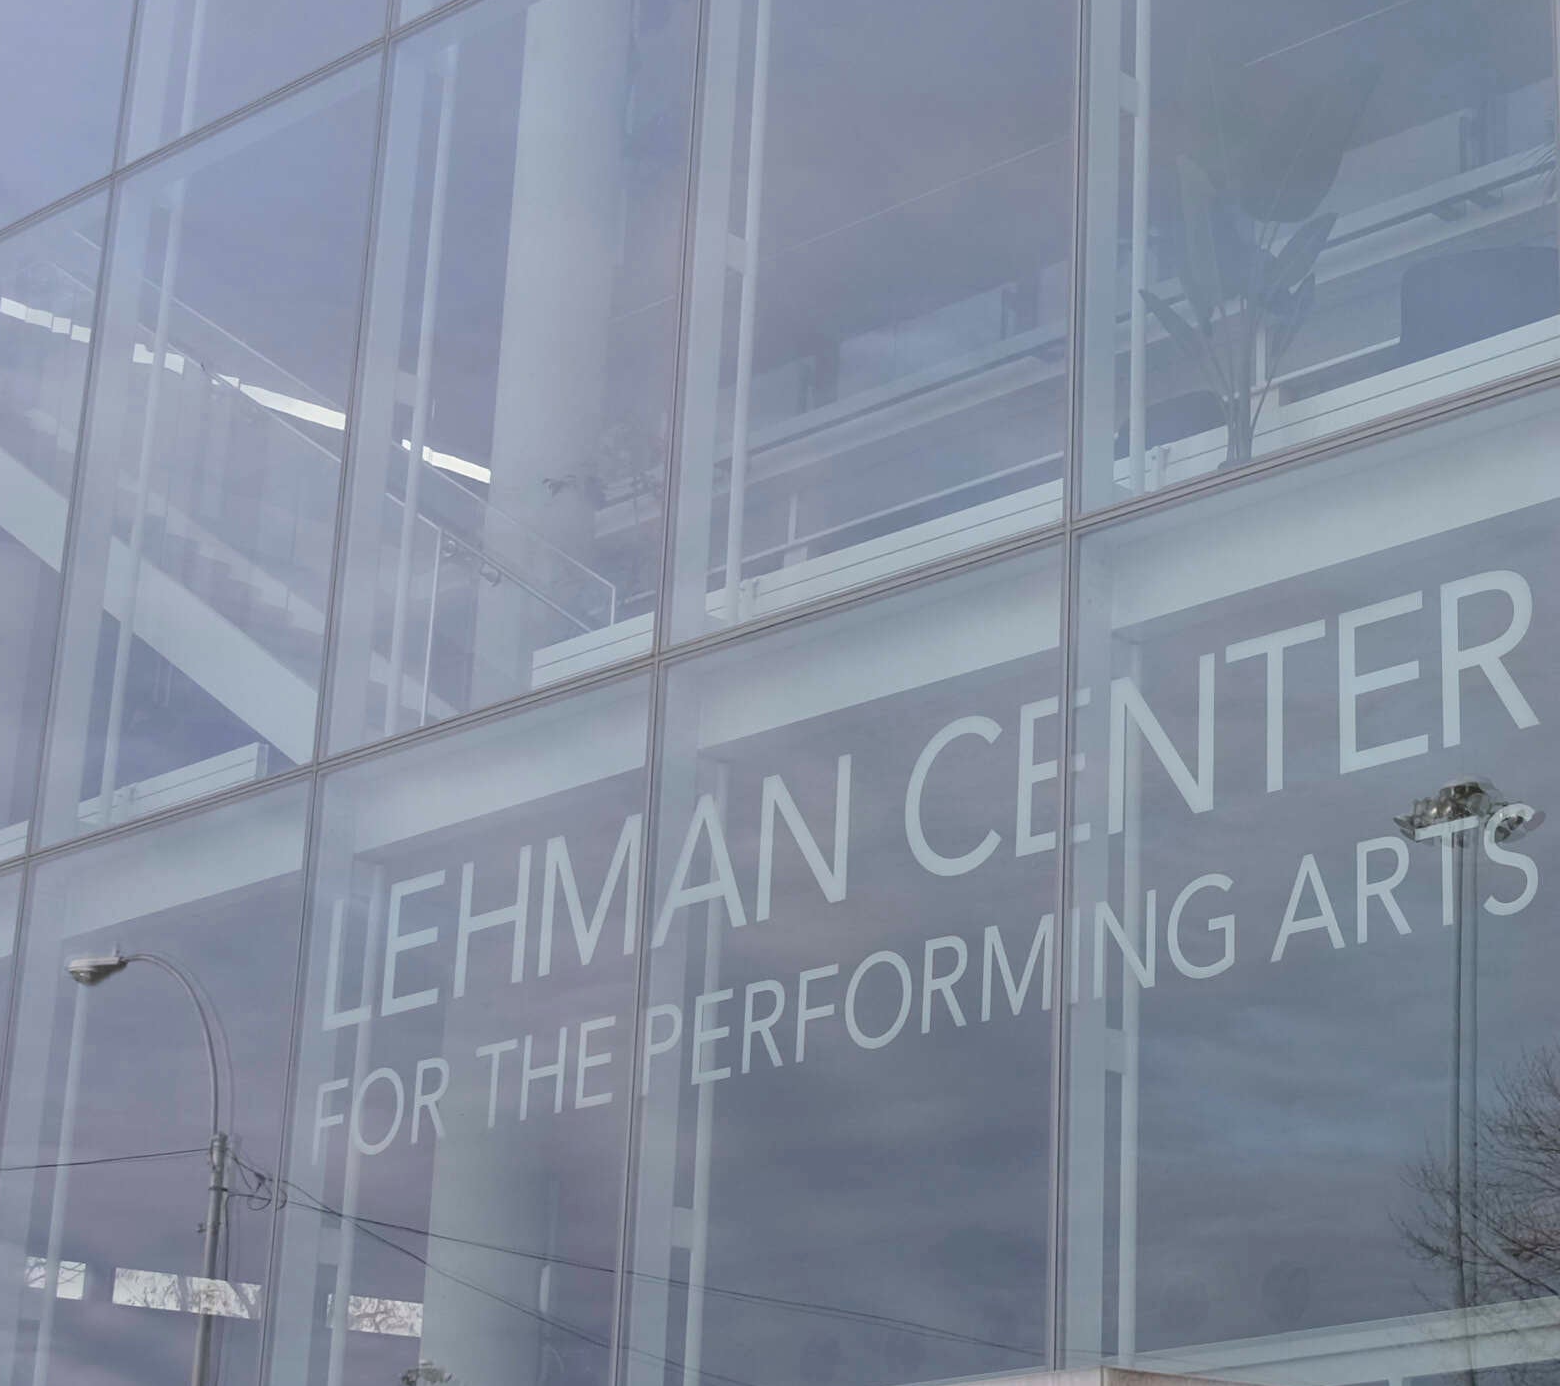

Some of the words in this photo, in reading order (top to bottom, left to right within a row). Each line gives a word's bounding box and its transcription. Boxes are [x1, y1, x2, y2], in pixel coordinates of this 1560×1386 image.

[312, 1057, 450, 1166] FOR
[475, 1015, 617, 1129] THE
[640, 872, 1236, 1097] PERFORMING
[1270, 802, 1540, 963] ARTS
[322, 753, 852, 1032] LEHMAN
[903, 569, 1541, 878] CENTER
